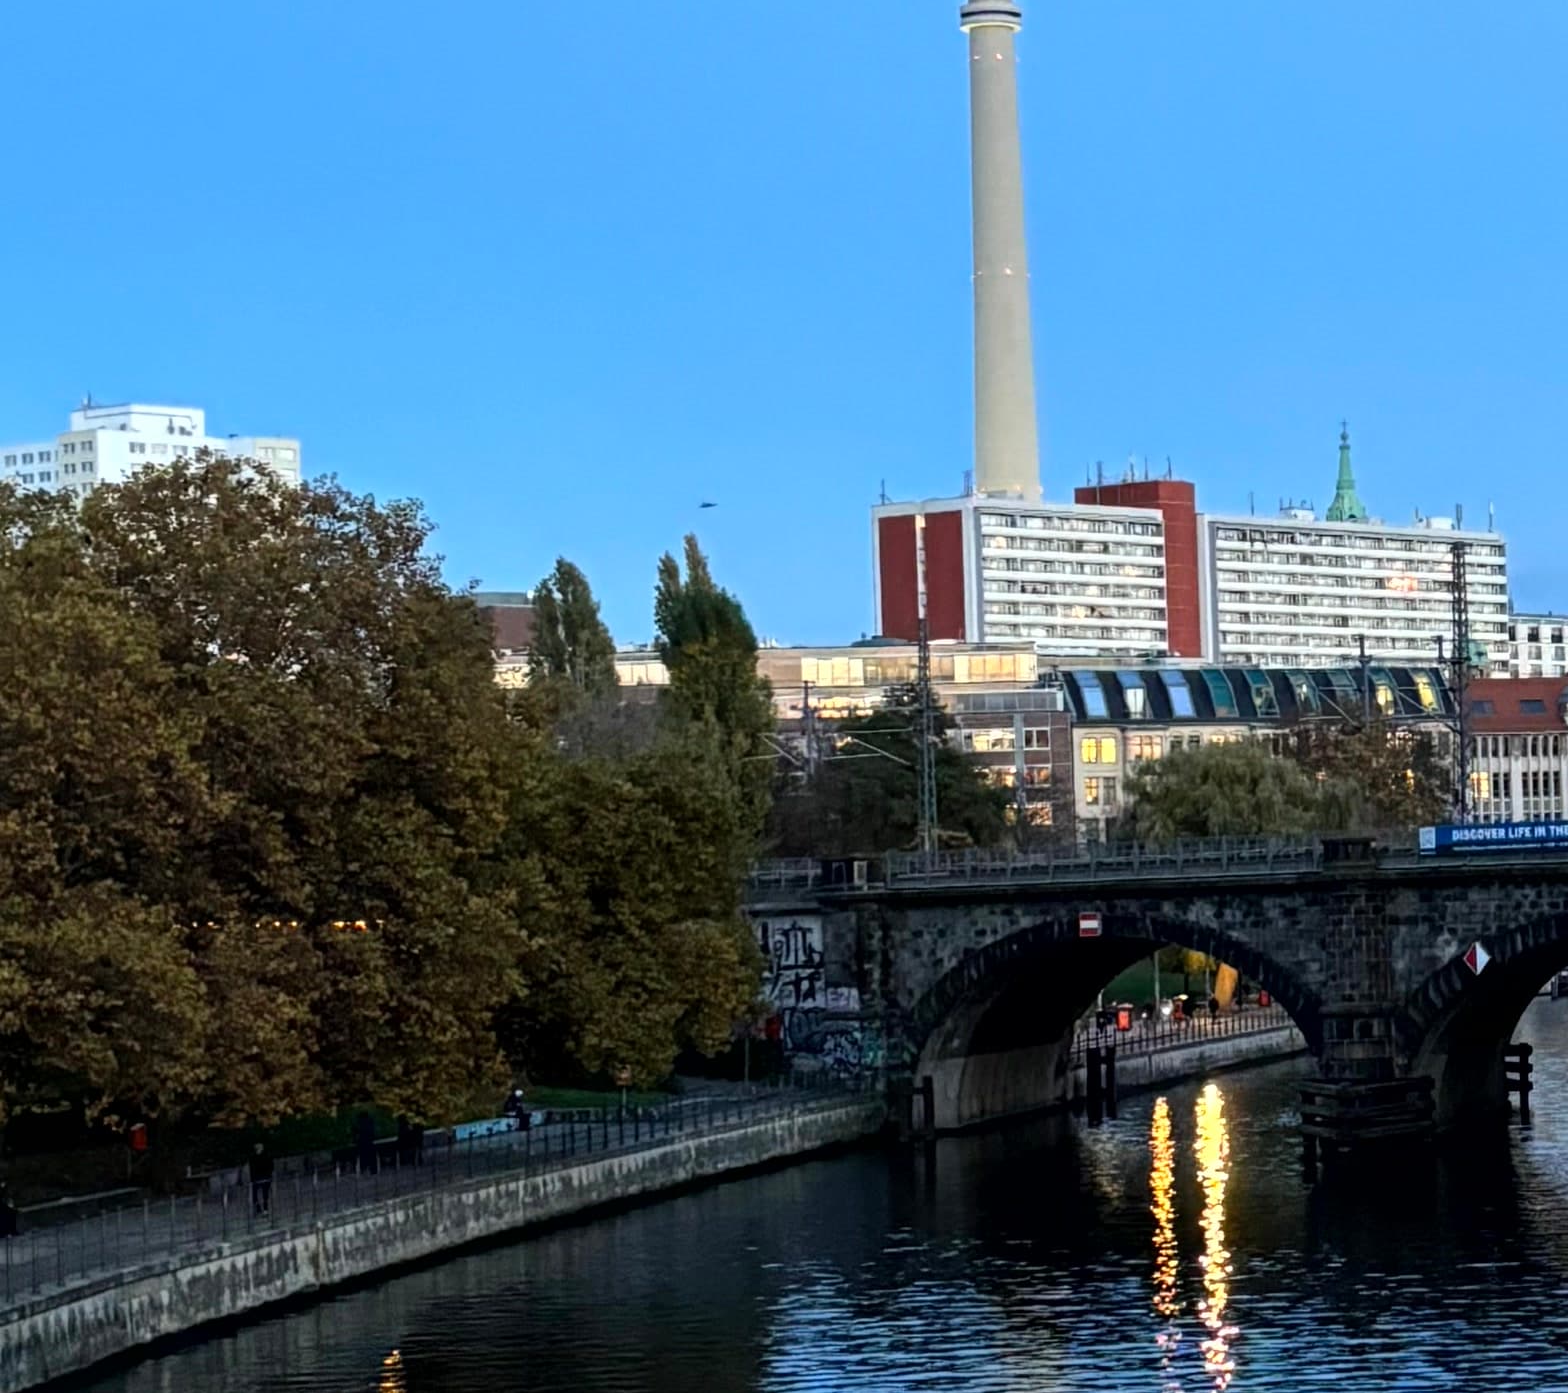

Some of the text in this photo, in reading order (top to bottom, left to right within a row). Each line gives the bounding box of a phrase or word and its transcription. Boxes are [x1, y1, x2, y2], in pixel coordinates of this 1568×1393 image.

[1451, 827, 1506, 842] DISCOVER
[1507, 826, 1531, 839] LIFE
[1534, 825, 1547, 838] IN
